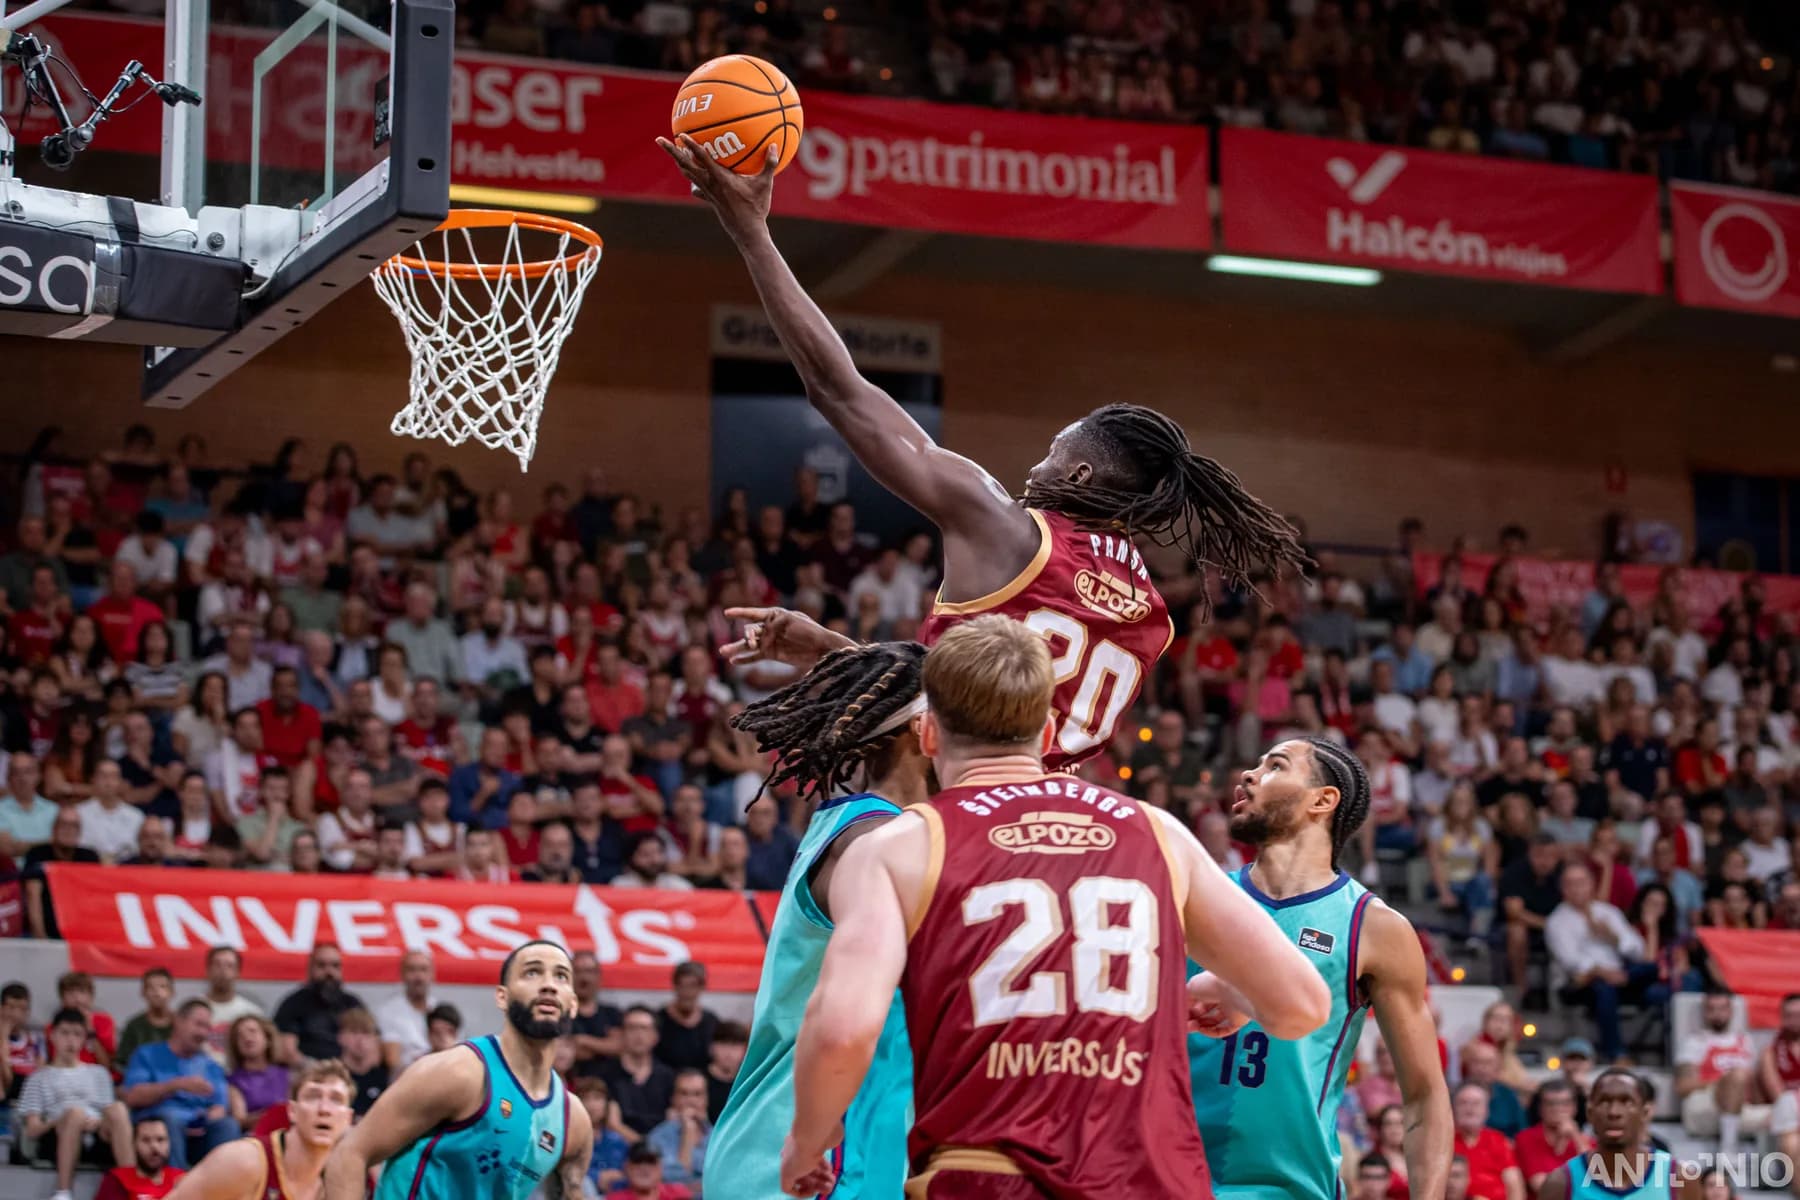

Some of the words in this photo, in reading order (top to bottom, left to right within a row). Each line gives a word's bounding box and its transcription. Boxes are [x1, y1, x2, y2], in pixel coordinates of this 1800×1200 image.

[1326, 206, 1491, 269] Halcón
[960, 875, 1160, 1029] 28
[1219, 1030, 1270, 1089] 13
